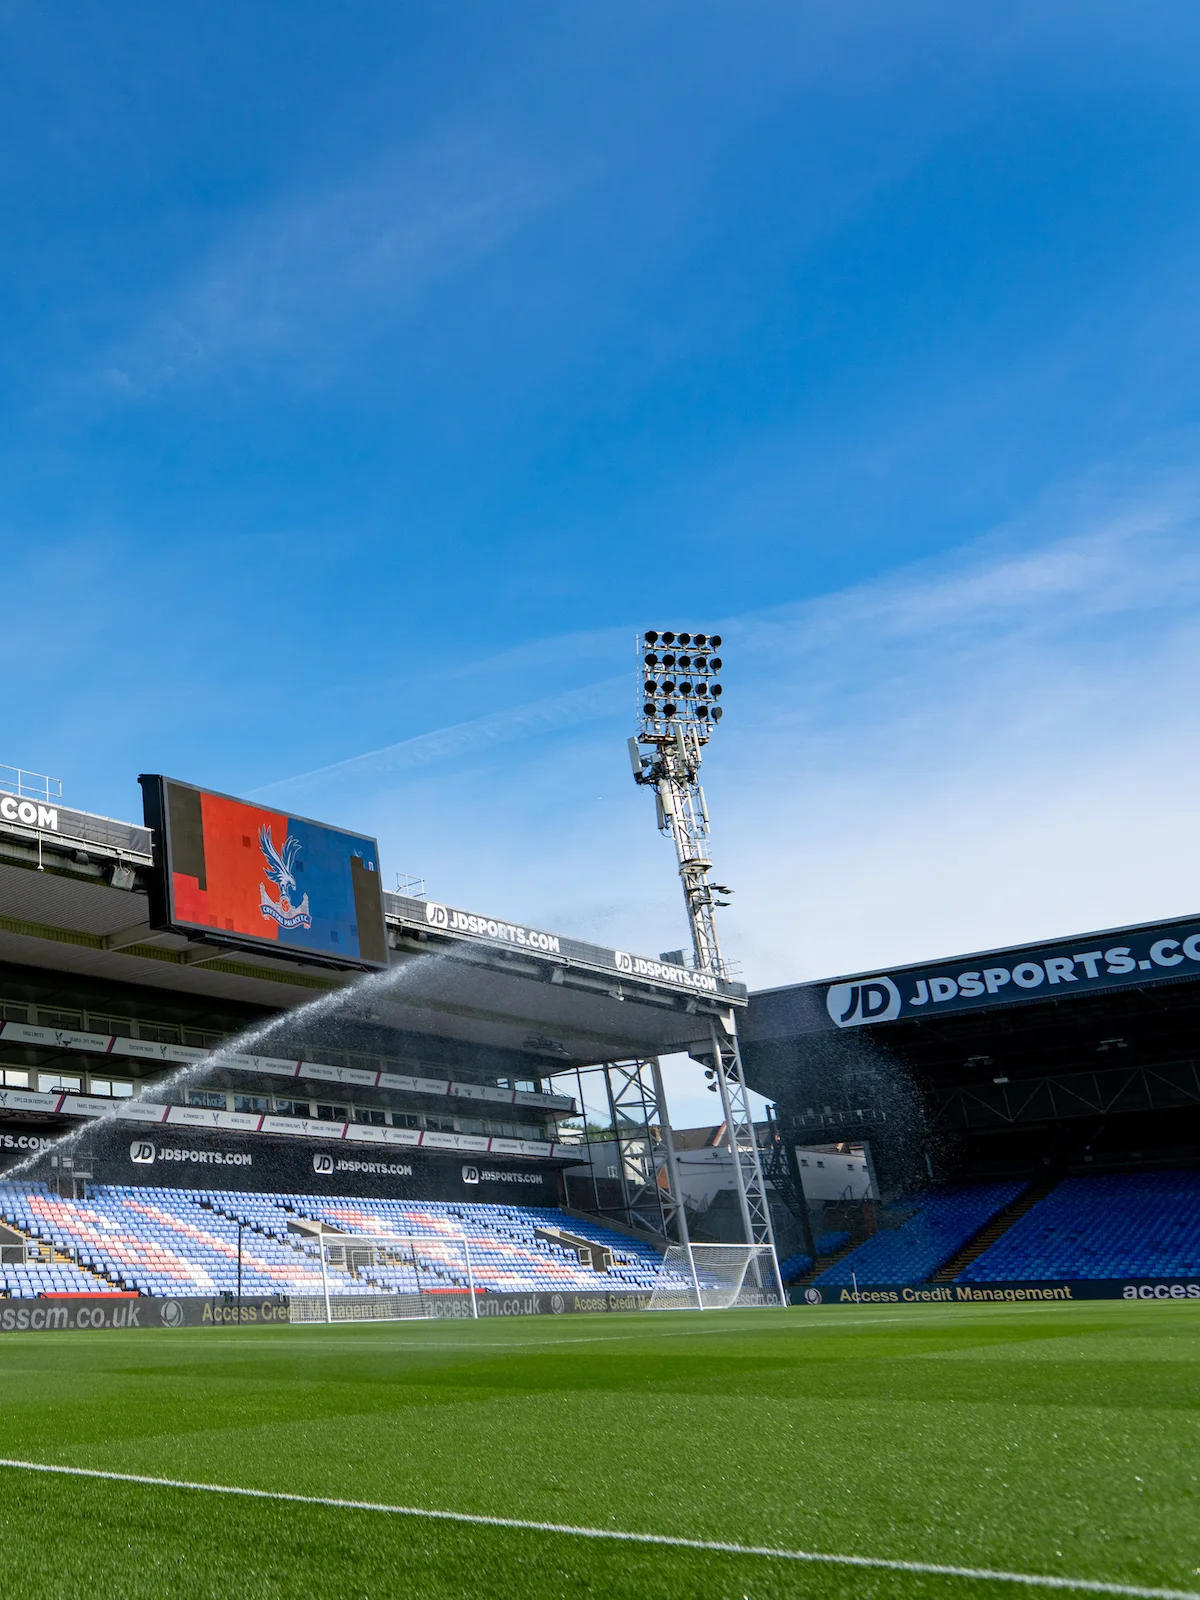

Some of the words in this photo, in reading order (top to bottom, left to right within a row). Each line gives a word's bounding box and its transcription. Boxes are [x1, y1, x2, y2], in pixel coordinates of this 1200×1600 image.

[450, 911, 560, 953] JDSPORTS.COM
[633, 958, 717, 992] JDSPORTS.COM
[157, 1148, 253, 1167] JDSPORTS.COM
[335, 1160, 413, 1176] JDSPORTS.COM
[480, 1171, 543, 1185] JDSPORTS.COM
[717, 1290, 792, 1306] accesscm.co.k
[840, 1288, 898, 1303] Access
[902, 1287, 953, 1302] Credit
[956, 1285, 1073, 1303] Management
[1123, 1284, 1200, 1300] acces
[574, 1296, 607, 1311] Access
[609, 1293, 636, 1309] Credit
[202, 1303, 257, 1322] Access
[261, 1301, 308, 1321] Credit
